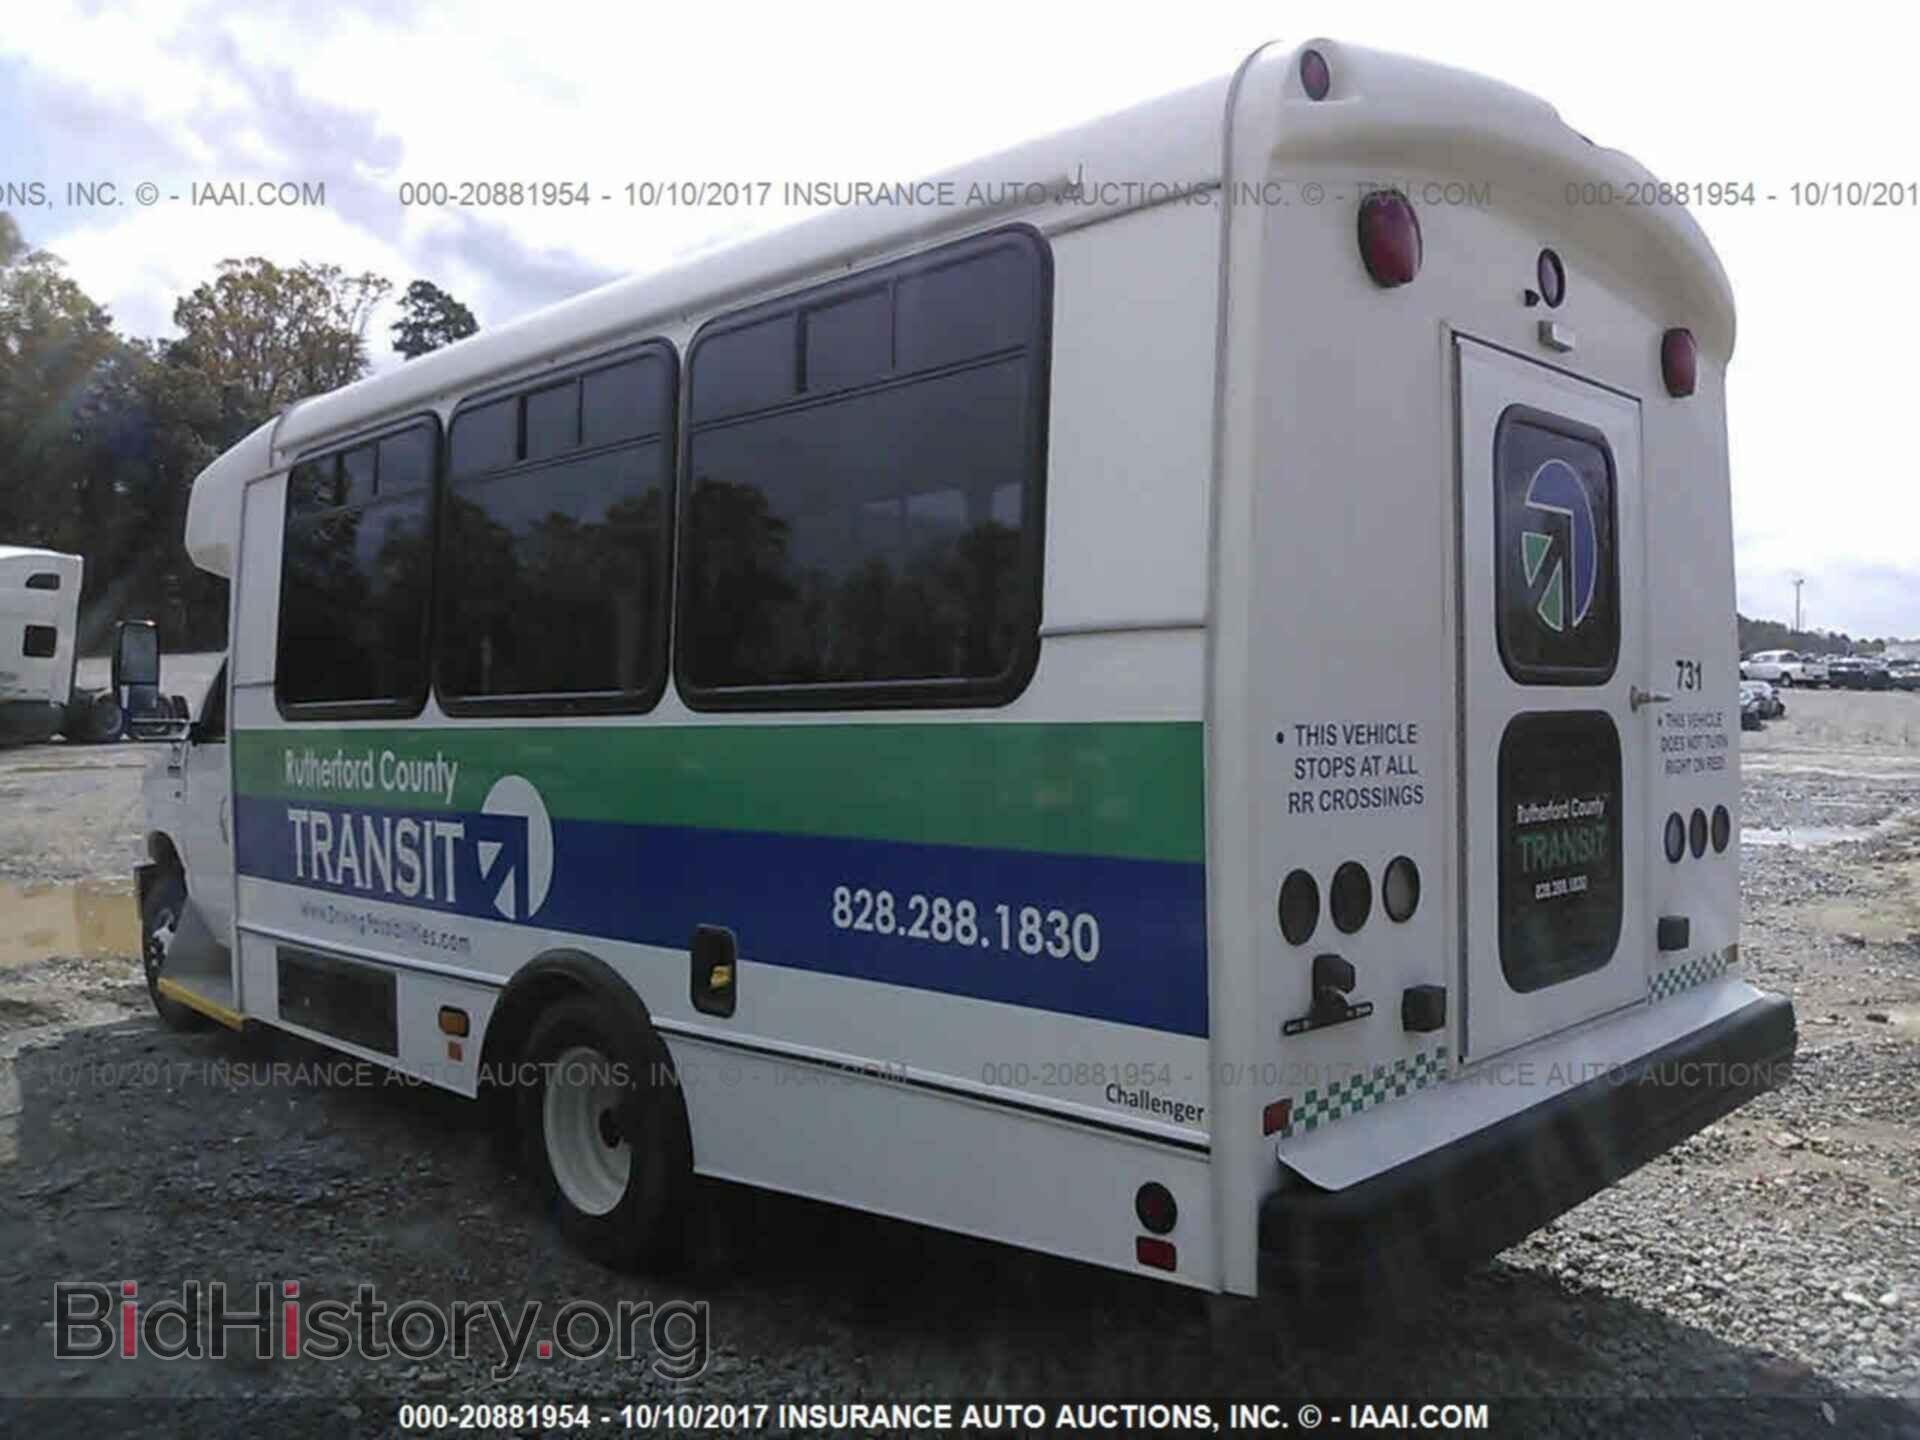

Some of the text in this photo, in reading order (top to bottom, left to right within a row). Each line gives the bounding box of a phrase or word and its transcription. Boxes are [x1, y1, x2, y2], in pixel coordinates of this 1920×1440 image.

[1675, 659, 1702, 691] 731
[1295, 723, 1418, 747] THIS VEHICLE
[284, 749, 458, 805] Rutherford County
[1294, 754, 1418, 780] STOPS AT ALL
[1288, 785, 1425, 815] RR CROSSINGS
[287, 808, 465, 903] TRANSIT
[1516, 824, 1608, 873] TRANSIT
[832, 885, 1100, 963] 828.288.1830
[1105, 1083, 1205, 1122] Challenger
